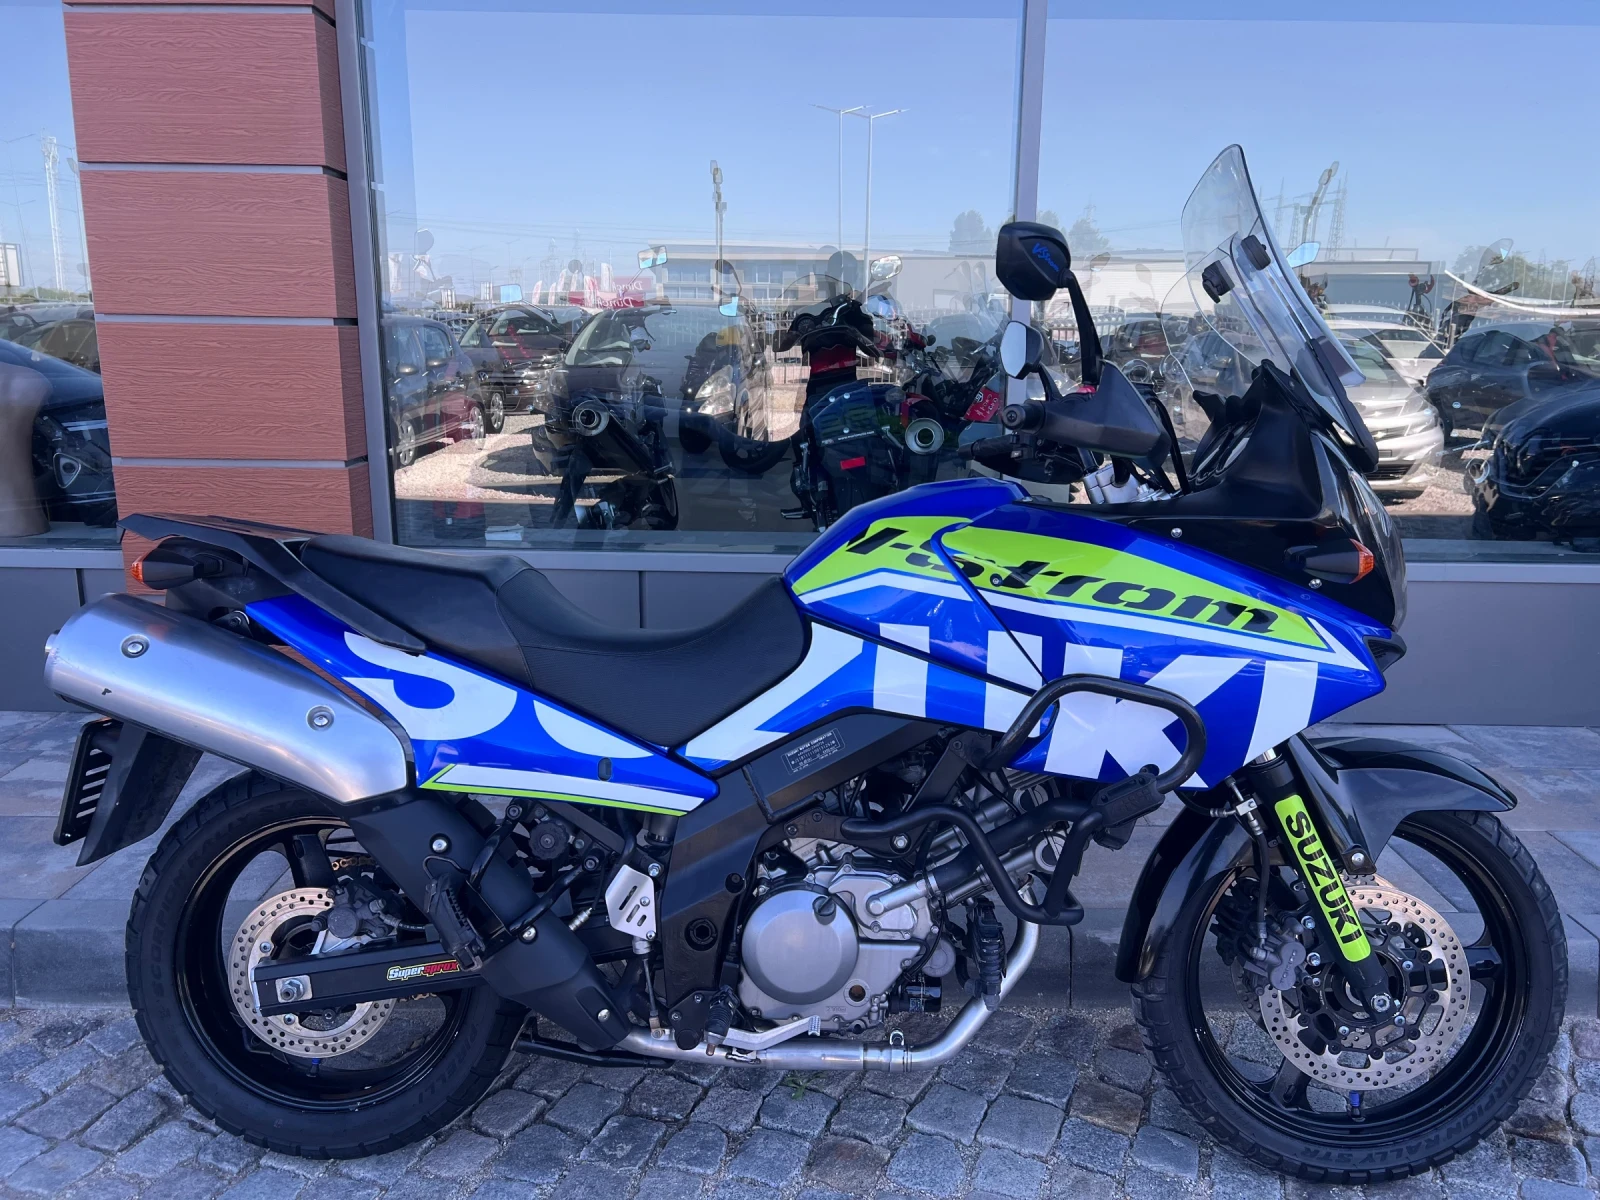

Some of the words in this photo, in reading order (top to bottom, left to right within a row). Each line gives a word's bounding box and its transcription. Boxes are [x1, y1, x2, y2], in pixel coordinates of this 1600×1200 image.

[1285, 810, 1363, 944] SUZUKI
[388, 961, 459, 979] Supersprox
[1447, 1032, 1535, 1140] SCORPION
[1359, 1134, 1442, 1164] RALLY
